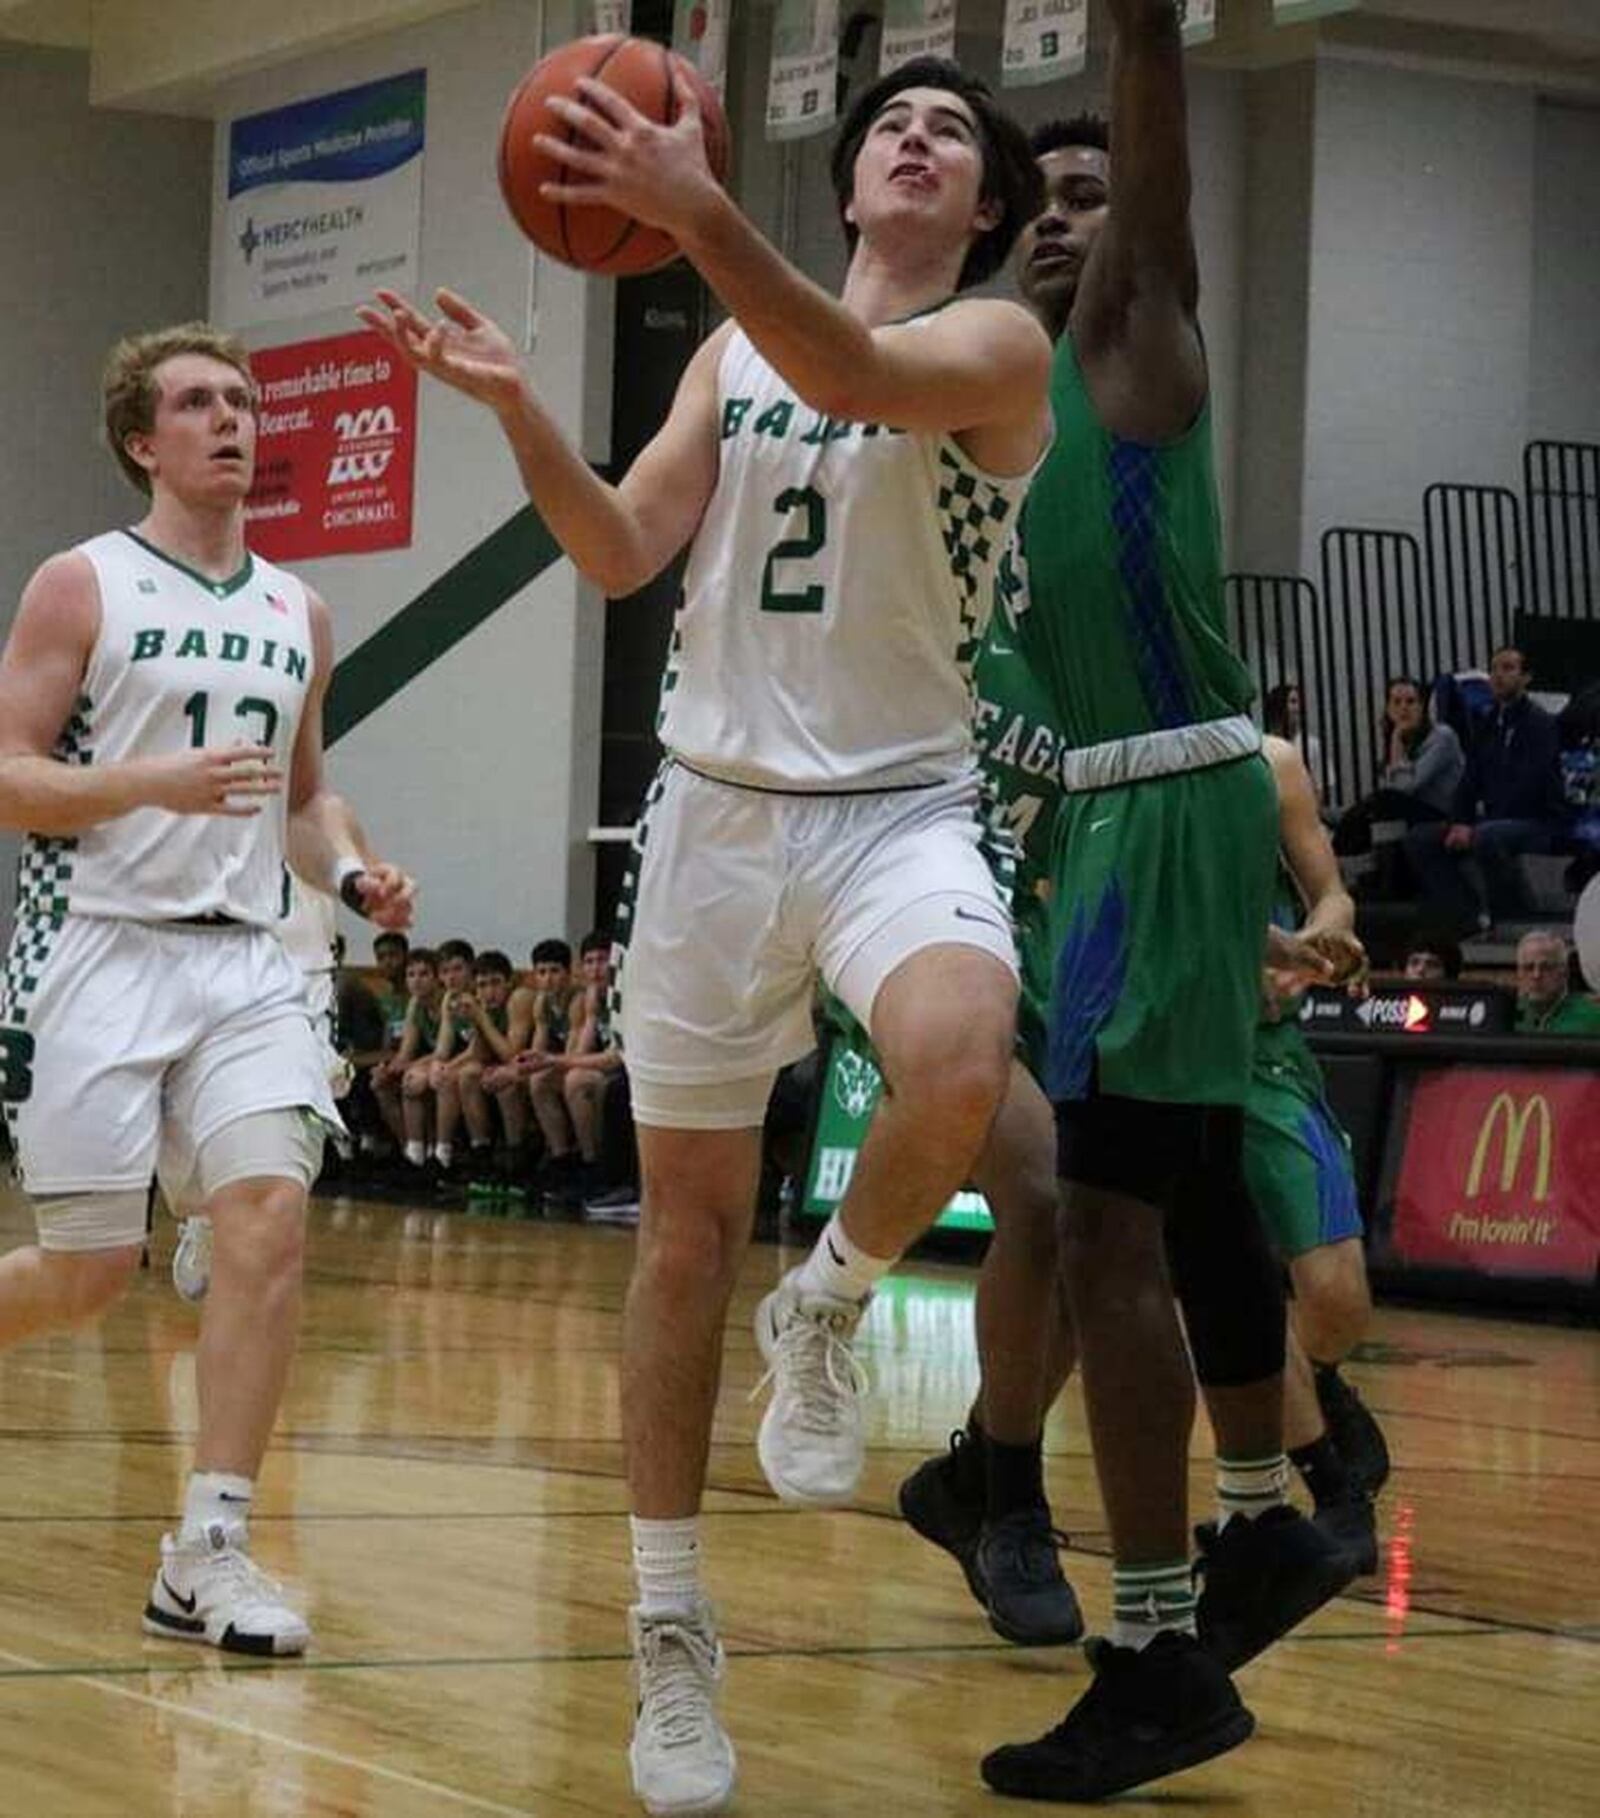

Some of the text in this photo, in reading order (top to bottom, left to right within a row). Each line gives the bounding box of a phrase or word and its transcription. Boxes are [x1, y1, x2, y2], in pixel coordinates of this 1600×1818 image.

[264, 361, 341, 404] remarkable
[343, 360, 374, 389] time
[375, 355, 391, 381] to
[760, 484, 827, 613] 2
[130, 628, 306, 683] BADIN
[814, 1148, 859, 1200] H
[1449, 1212, 1480, 1243] I'm
